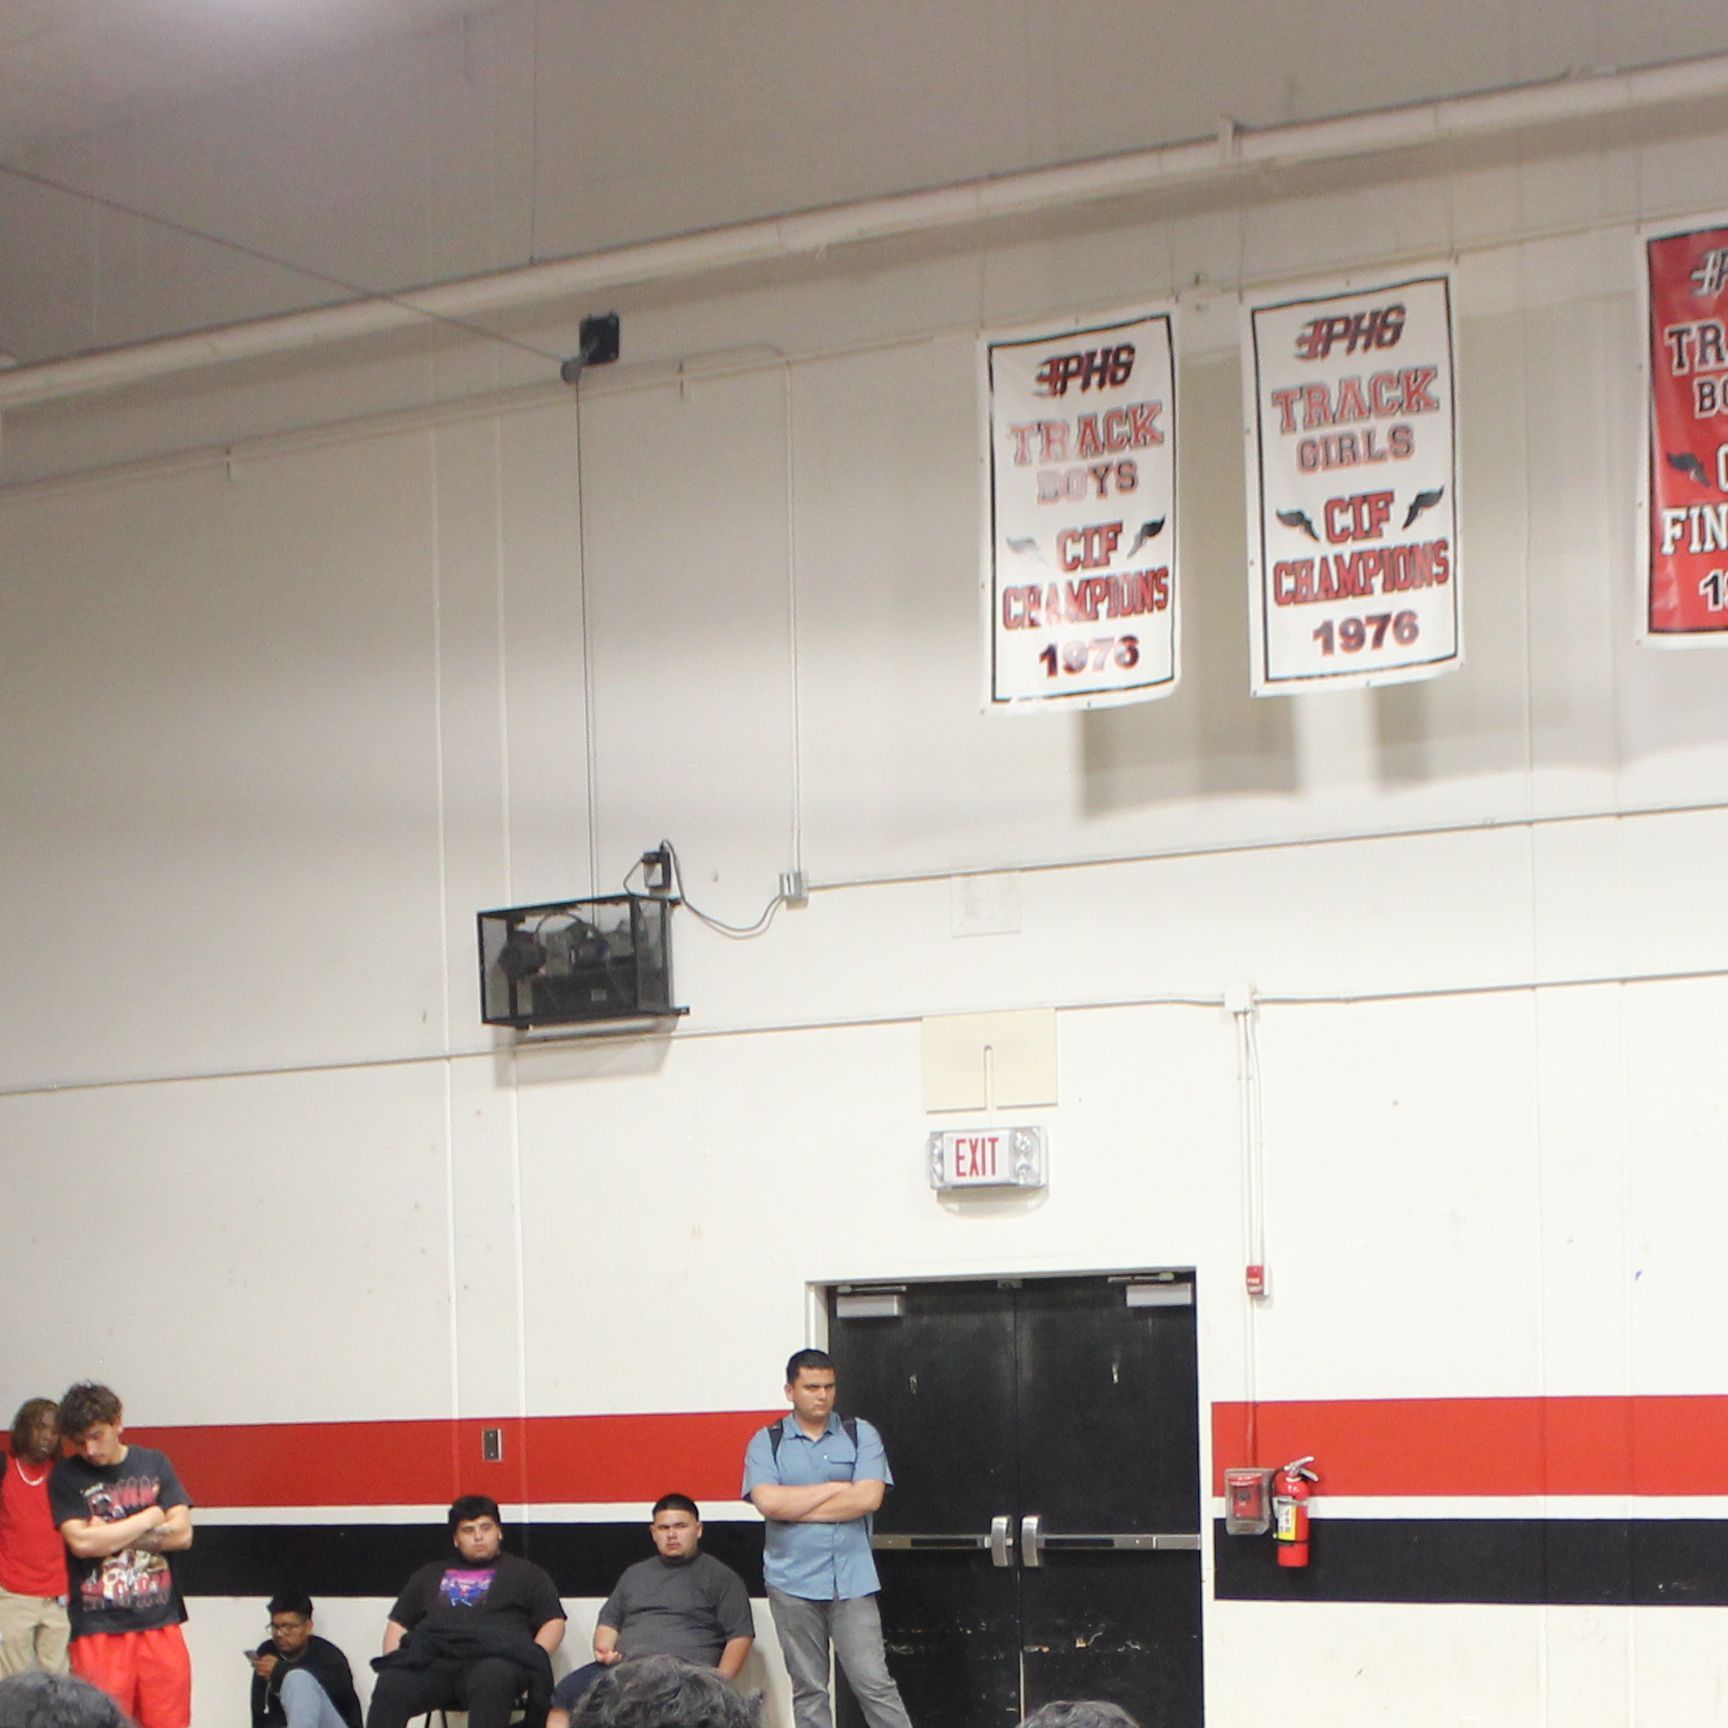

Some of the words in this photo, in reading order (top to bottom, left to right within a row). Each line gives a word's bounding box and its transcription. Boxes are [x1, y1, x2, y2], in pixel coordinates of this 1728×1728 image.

[1295, 303, 1407, 360] PHS
[1036, 343, 1137, 397] PHS
[1272, 365, 1440, 435] TRACK
[1008, 401, 1165, 466] TRACK
[1297, 425, 1416, 474] GIRLS
[1037, 459, 1139, 503] BOYS
[1324, 490, 1395, 545] CIF
[1057, 521, 1123, 571] CIF
[1273, 536, 1450, 607] CHAMPIONS
[1002, 566, 1169, 630] CHAMPIONS
[1312, 610, 1419, 658] 1976
[956, 1137, 999, 1177] EXIT
